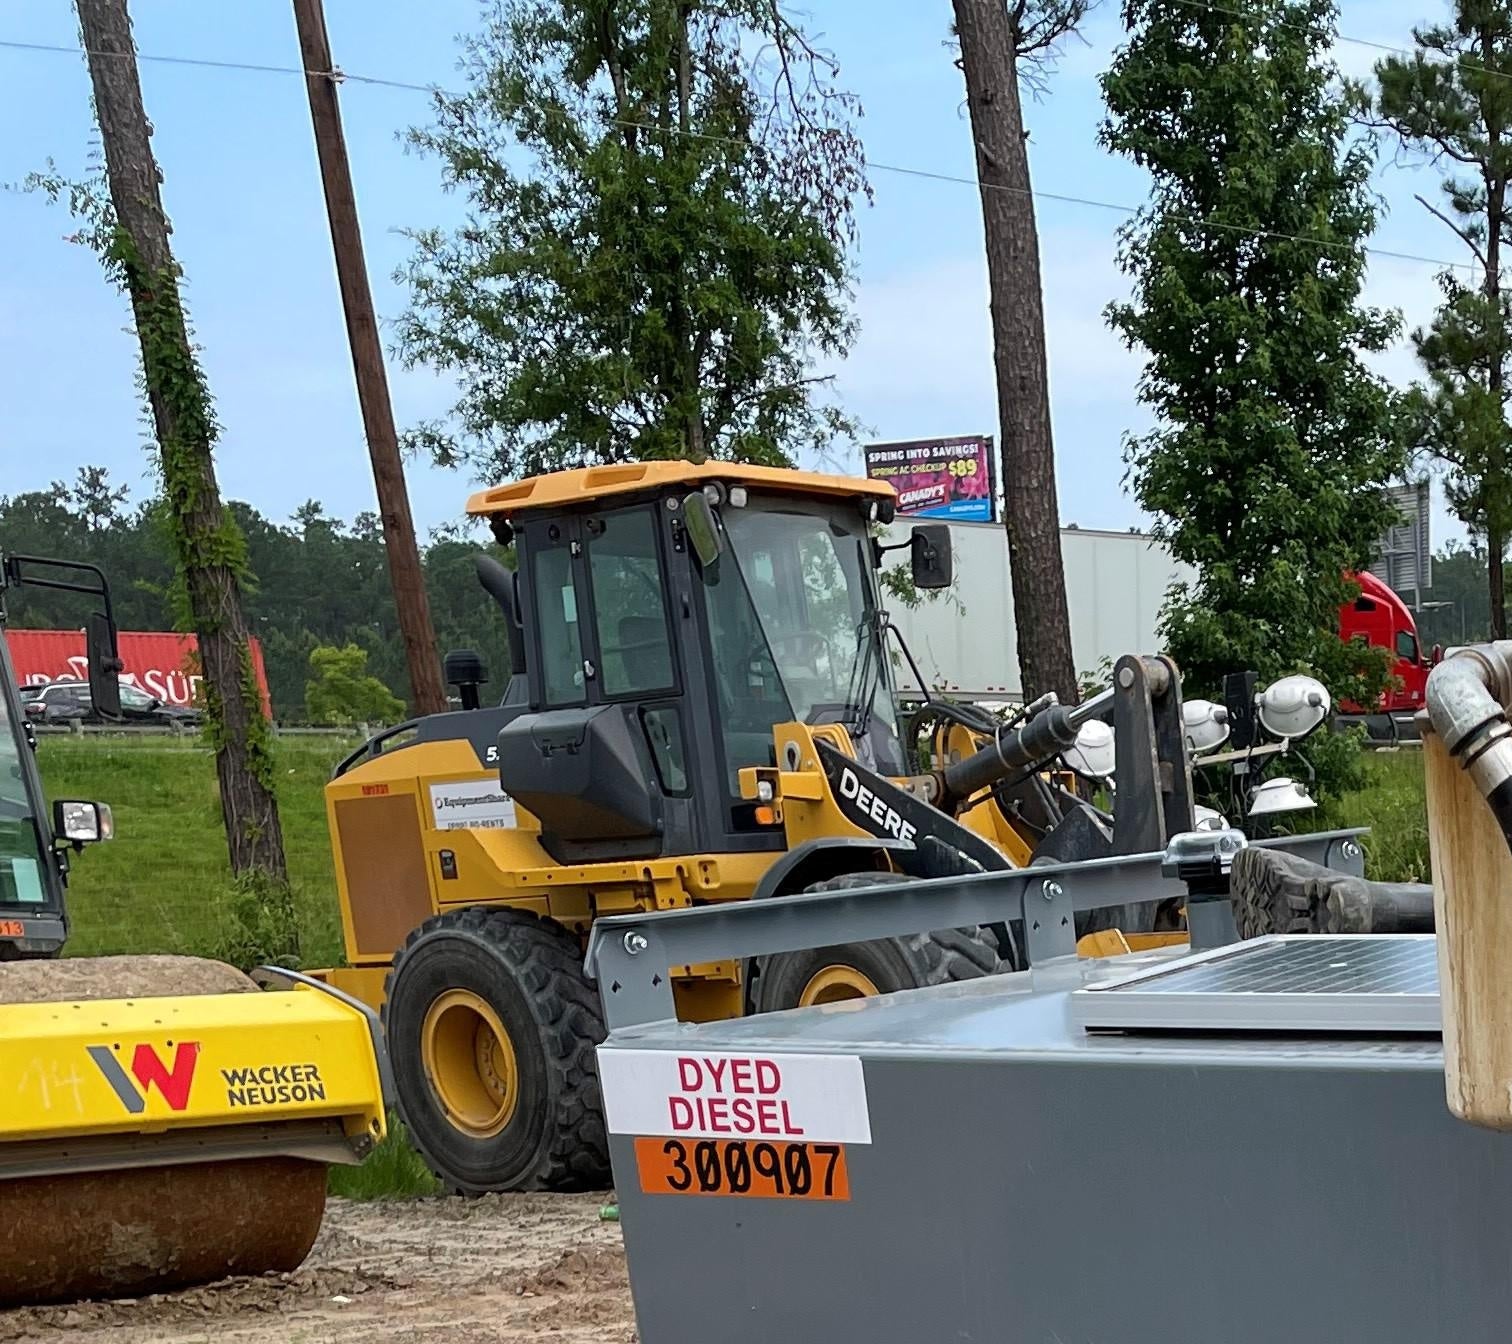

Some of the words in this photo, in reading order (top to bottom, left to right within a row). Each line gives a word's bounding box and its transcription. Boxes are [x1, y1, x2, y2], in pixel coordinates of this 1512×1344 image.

[868, 450, 905, 463] SPRING
[906, 448, 931, 460] INTO
[932, 443, 979, 458] SAVINGS!
[871, 465, 899, 477] SPRING
[899, 464, 911, 475] AC
[911, 462, 947, 474] CHECKUP
[899, 483, 946, 504] CANADY'S
[839, 767, 918, 841] DEERE
[0, 920, 23, 936] 13
[221, 1065, 322, 1087] WACKER
[677, 1058, 781, 1094] DYED
[228, 1083, 326, 1107] NEUSON
[668, 1096, 804, 1135] DIESEL
[663, 1140, 841, 1197] 300907
